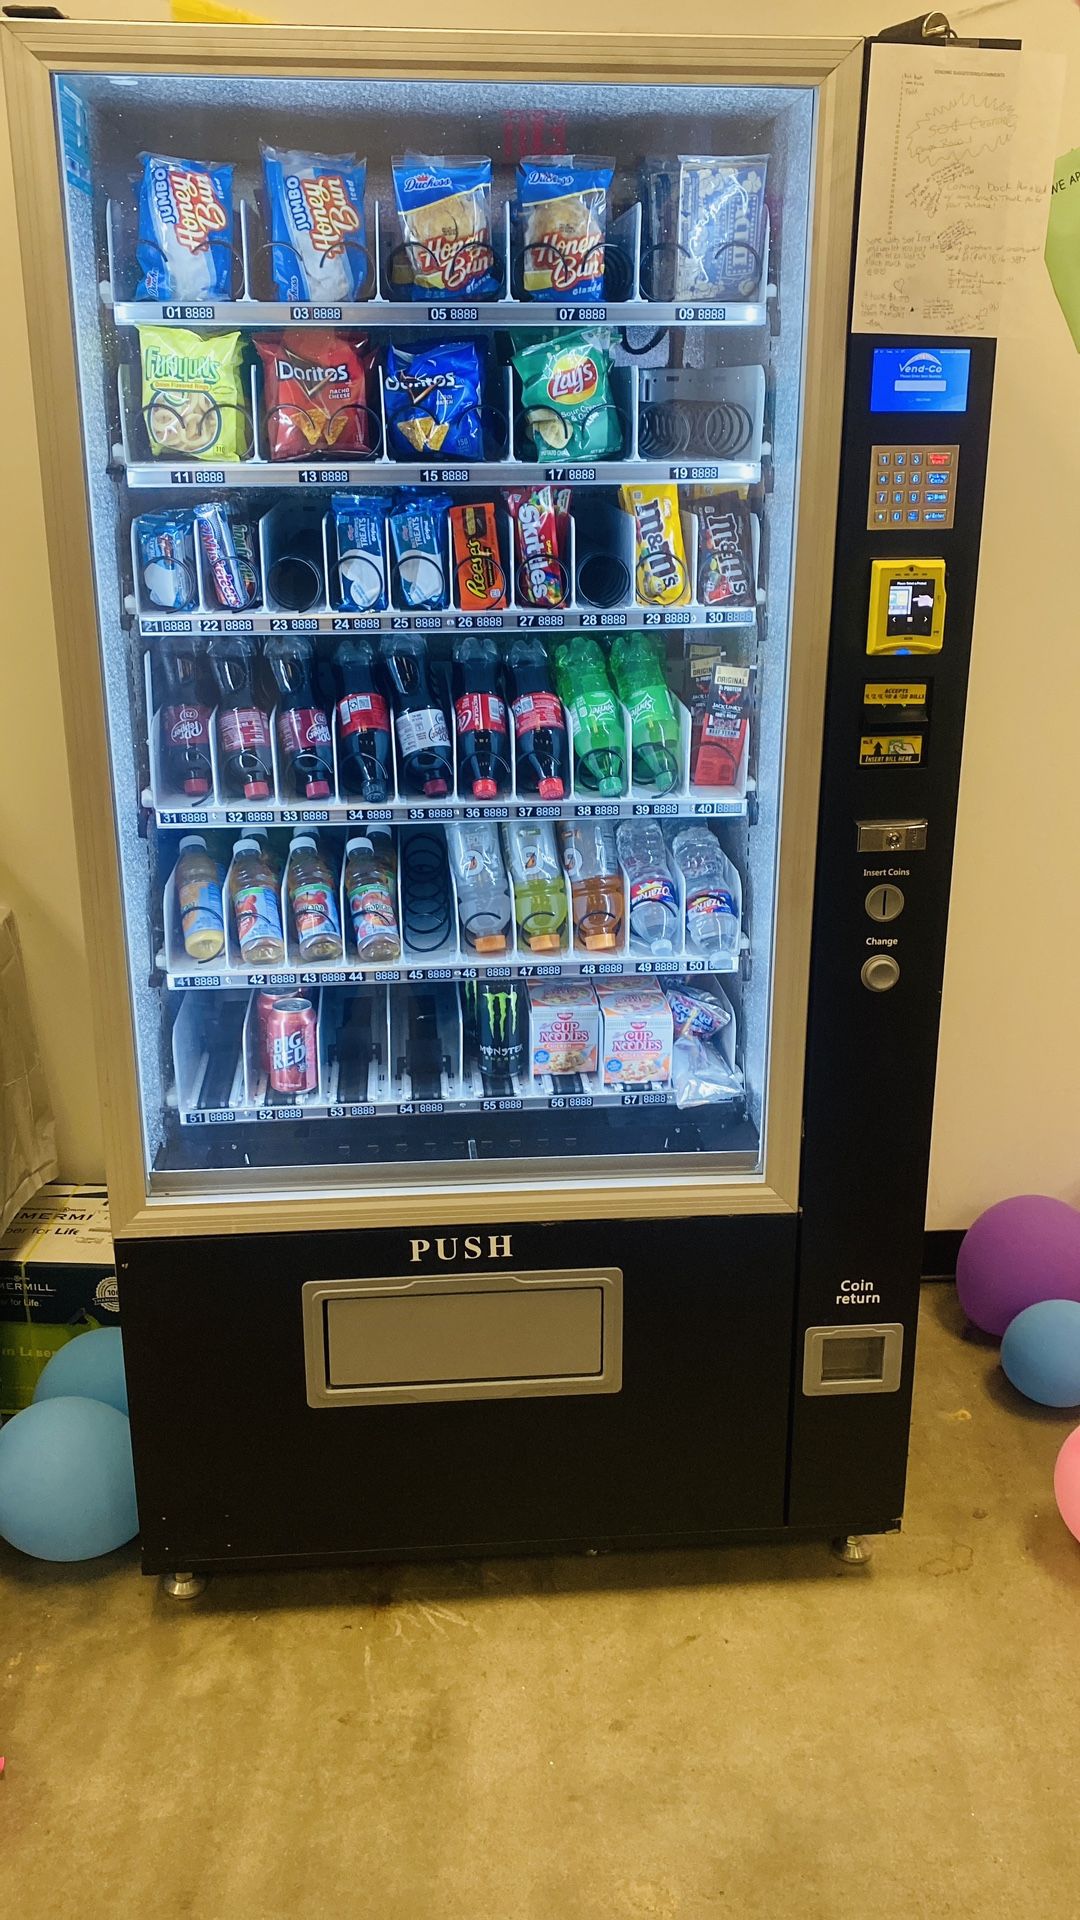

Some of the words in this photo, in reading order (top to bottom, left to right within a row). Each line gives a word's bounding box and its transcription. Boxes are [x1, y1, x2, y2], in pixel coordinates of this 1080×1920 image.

[403, 174, 452, 192] Duchess
[151, 167, 175, 224] JUMBO
[194, 172, 228, 232] Bun
[286, 175, 311, 231] JUMBO
[326, 175, 360, 234] Bun
[170, 172, 205, 249] Honey
[303, 178, 342, 252] Honey
[420, 232, 486, 268] Honey
[538, 232, 605, 266] Honey
[444, 254, 489, 288] Bun
[552, 255, 603, 288] Bun
[166, 307, 182, 318] 01
[293, 307, 310, 319] 03
[430, 308, 447, 319] 05
[559, 308, 575, 319] 07
[679, 309, 694, 320] 09
[276, 360, 349, 382] Doritos
[898, 363, 943, 373] Vend-Co
[551, 362, 597, 397] Lay's
[175, 473, 189, 483] 11
[301, 471, 316, 482] 13
[423, 471, 438, 482] 15
[549, 469, 563, 481] 17
[673, 468, 688, 479] 19
[359, 517, 368, 547] TREATS
[412, 516, 423, 547] TREATS
[518, 503, 549, 599] Skittles
[466, 539, 488, 599] Reese's
[458, 617, 473, 627] 26
[519, 616, 534, 626] 27
[582, 615, 597, 626] 28
[646, 613, 661, 624] 29
[708, 612, 723, 623] 30
[145, 622, 159, 632] 21
[203, 621, 219, 631] 22
[334, 619, 350, 630] 24
[393, 618, 409, 628] 25
[693, 667, 712, 676] ORIGIN
[717, 675, 746, 685] ORIGINAL
[172, 720, 203, 737] Pepper
[410, 809, 424, 819] 35
[466, 808, 480, 818] 36
[518, 807, 533, 817] 37
[577, 806, 591, 816] 38
[635, 805, 650, 815] 39
[697, 804, 712, 814] 40
[163, 813, 177, 823] 31
[228, 812, 244, 822] 32
[283, 811, 298, 821] 33
[349, 810, 364, 820] 34
[863, 869, 886, 877] Insert
[887, 868, 910, 876] Coins
[866, 937, 898, 947] Change
[581, 964, 596, 974] 48
[637, 962, 652, 972] 49
[689, 960, 703, 970] 50
[349, 971, 363, 981] 44
[408, 970, 424, 980] 45
[462, 968, 477, 978] 46
[519, 966, 534, 976] 47
[177, 977, 191, 986] 41
[249, 974, 265, 984] 42
[302, 973, 317, 982] 43
[551, 1021, 580, 1032] CUP
[538, 1030, 590, 1042] NOODLES
[624, 1031, 653, 1041] CUP
[272, 1031, 303, 1054] BIG
[613, 1039, 663, 1051] NOODLES
[272, 1047, 306, 1070] RED
[551, 1098, 564, 1107] 56
[624, 1095, 637, 1104] 57
[400, 1104, 413, 1113] 54
[483, 1101, 496, 1110] 55
[259, 1110, 273, 1119] 52
[330, 1107, 344, 1116] 53
[189, 1113, 204, 1122] 51
[32, 1227, 51, 1235] for
[54, 1227, 80, 1236] Life
[409, 1234, 514, 1262] PUSH
[840, 1279, 874, 1292] Coin
[835, 1291, 881, 1305] return
